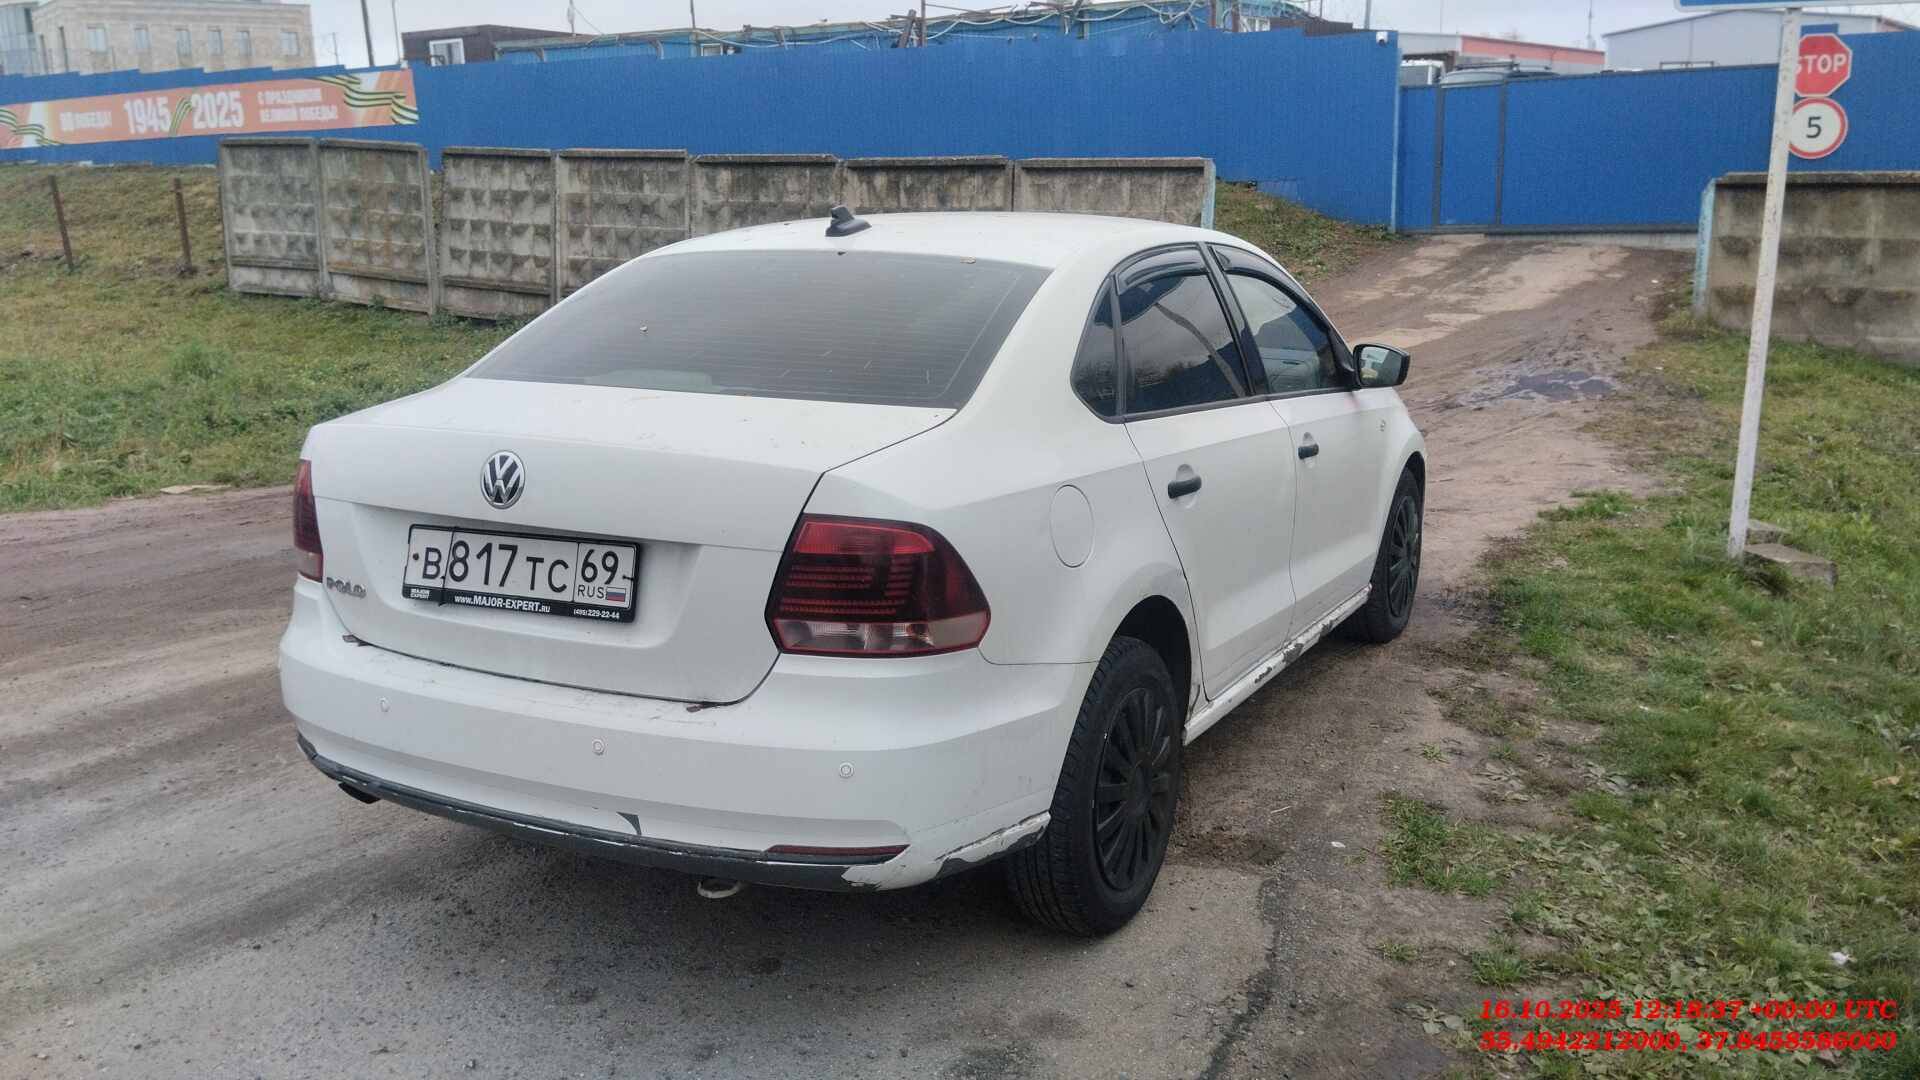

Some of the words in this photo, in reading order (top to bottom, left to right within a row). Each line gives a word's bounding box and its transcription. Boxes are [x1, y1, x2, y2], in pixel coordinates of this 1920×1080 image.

[123, 97, 171, 134] 1945
[191, 91, 244, 130] 2025
[1805, 116, 1823, 139] 5
[581, 548, 619, 585] 69
[577, 584, 605, 599] RUS
